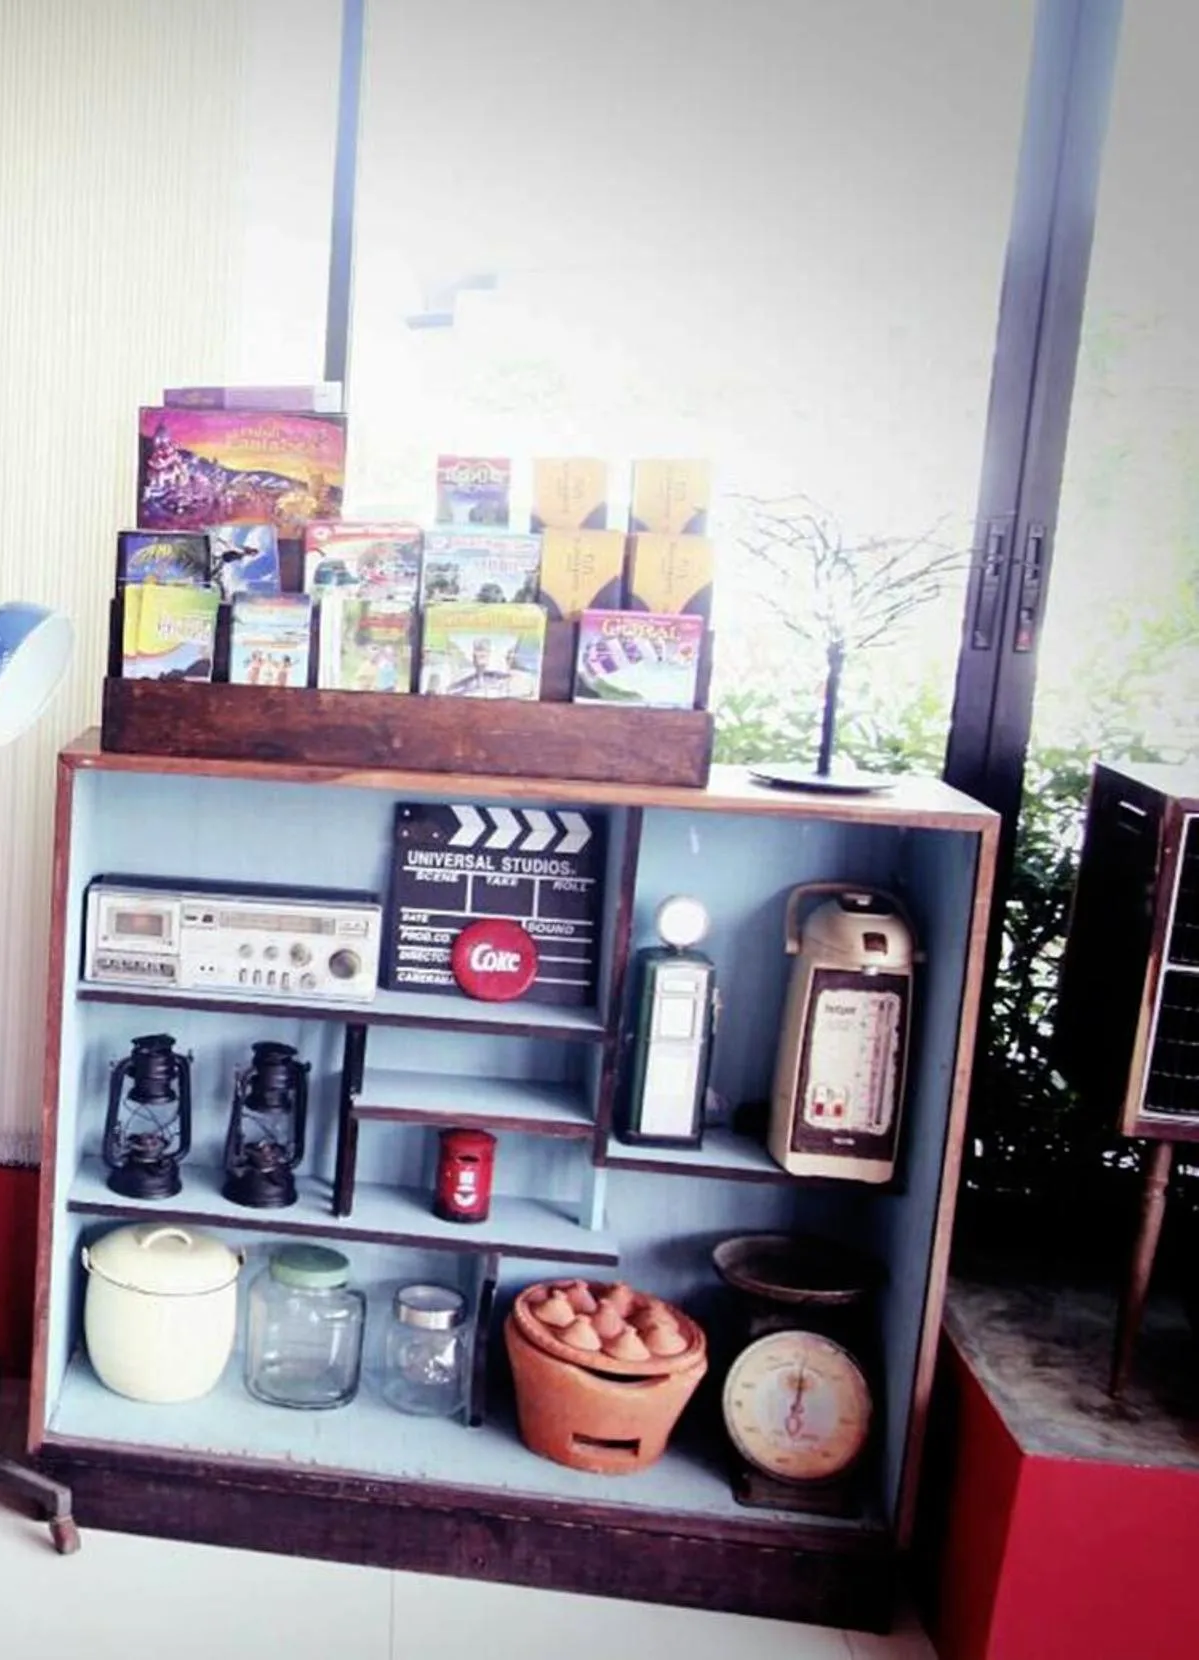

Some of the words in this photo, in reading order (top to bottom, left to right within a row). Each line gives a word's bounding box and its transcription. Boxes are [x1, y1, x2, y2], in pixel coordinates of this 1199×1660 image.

[407, 851, 495, 871] UNIVERSAL
[415, 871, 459, 883] SCENE
[486, 876, 518, 887] TAKE
[553, 880, 587, 892] ROLL
[402, 914, 429, 923] DATE
[528, 923, 575, 935] SOUND
